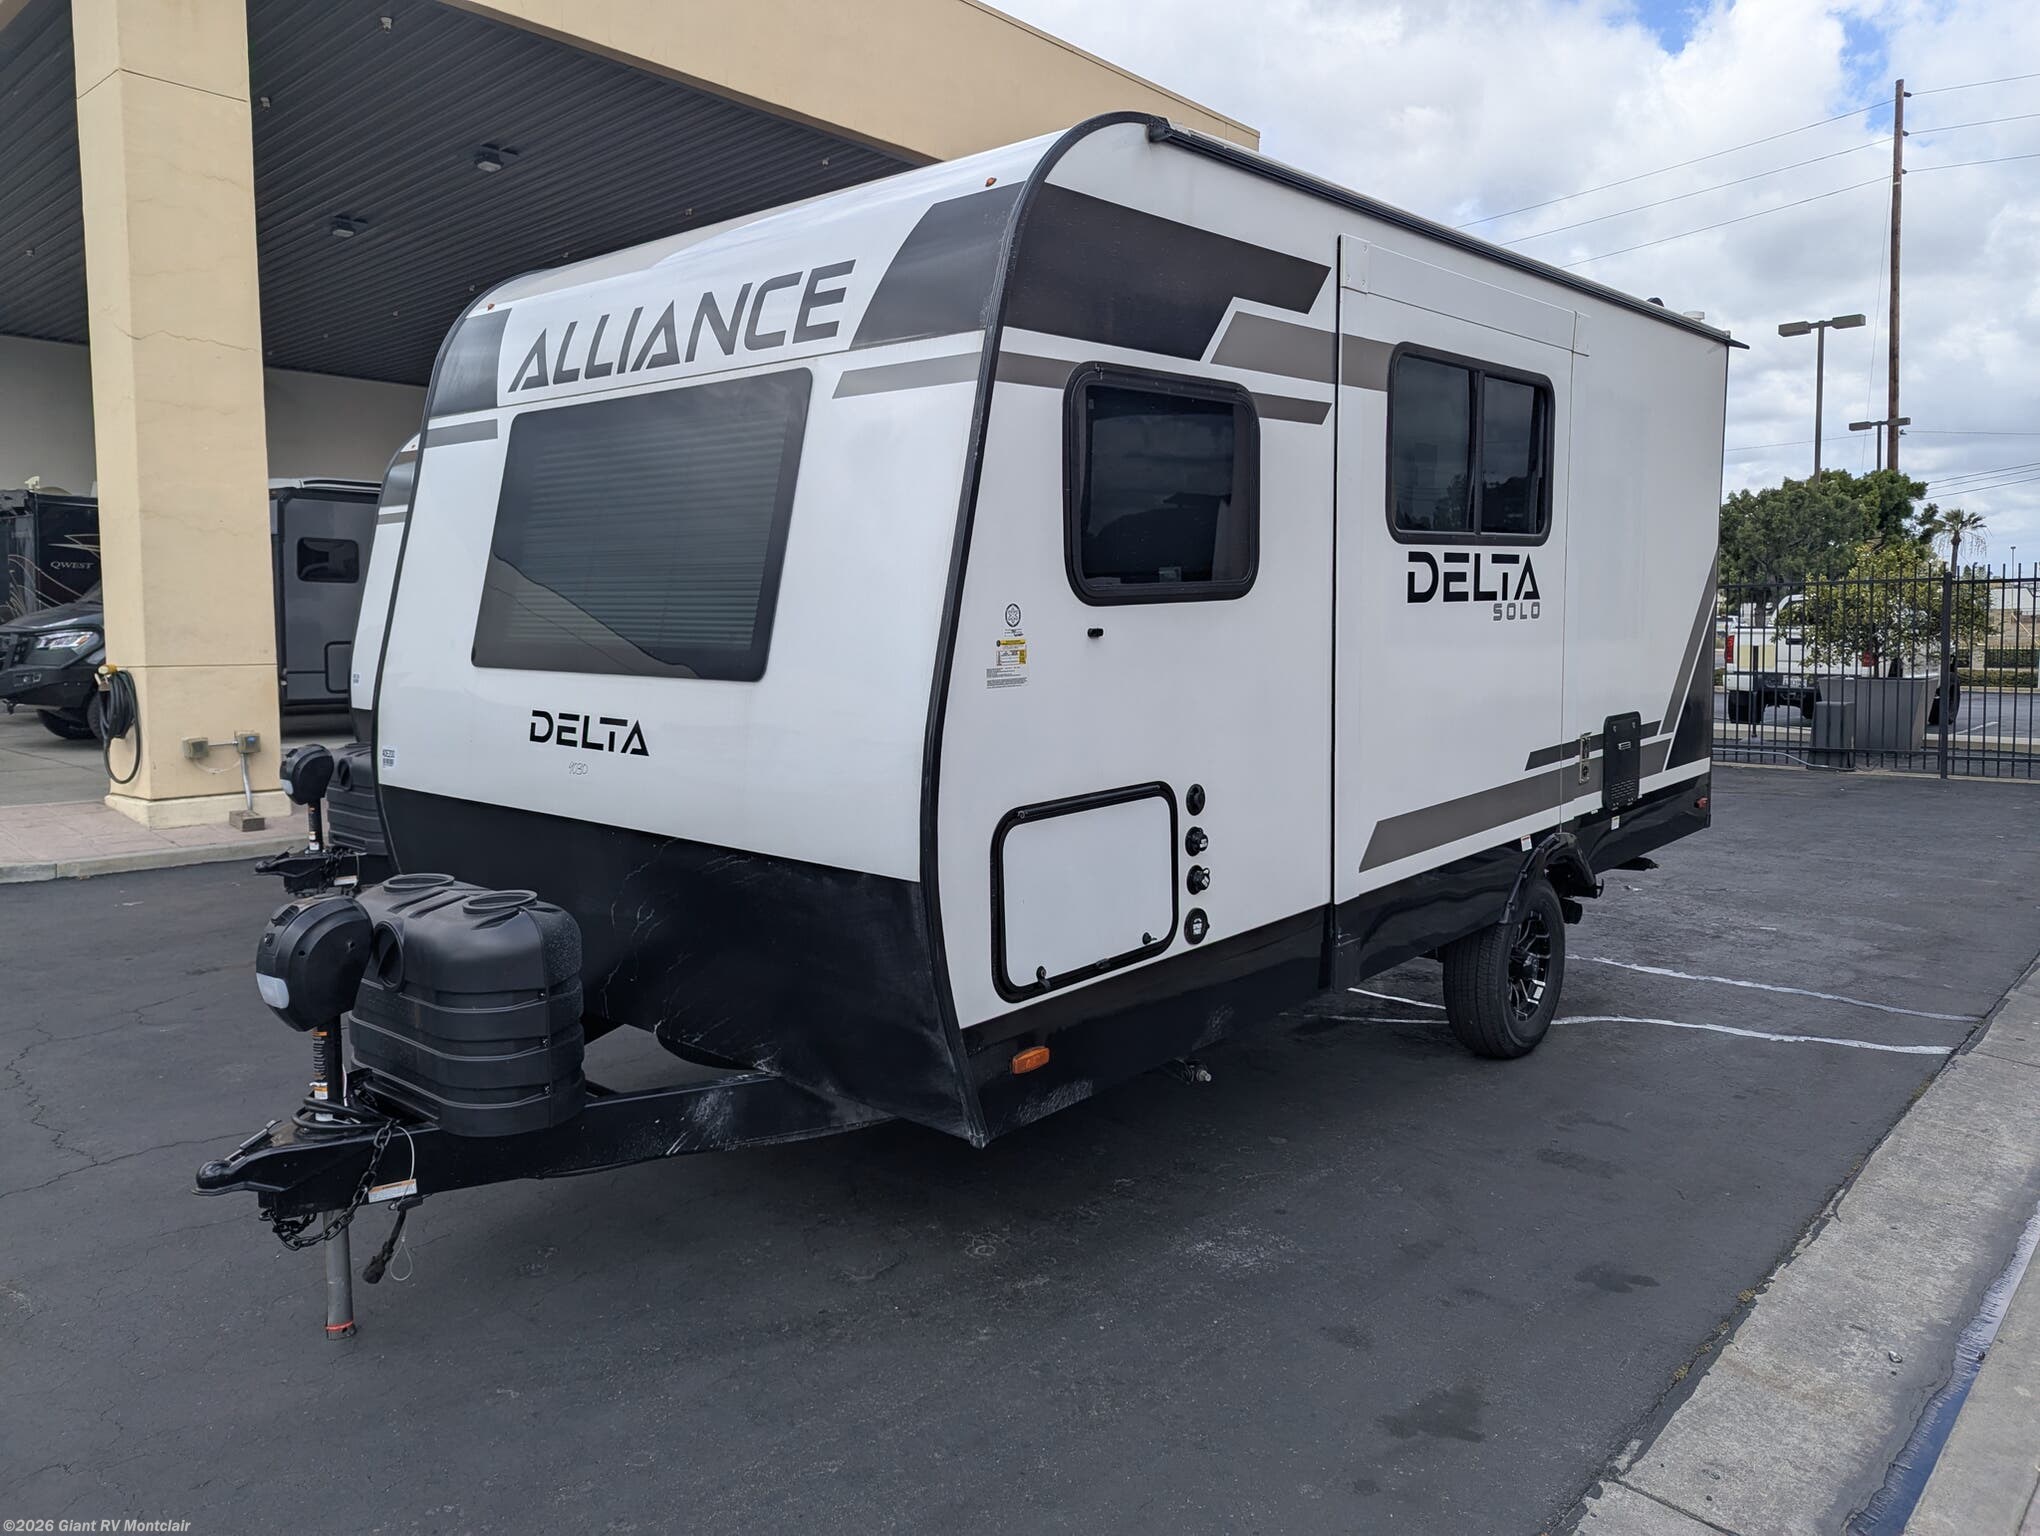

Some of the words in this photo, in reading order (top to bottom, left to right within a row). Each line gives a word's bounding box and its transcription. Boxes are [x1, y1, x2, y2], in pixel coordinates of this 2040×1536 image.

[507, 259, 857, 394] ALLIANCE
[50, 560, 96, 570] QWEST
[1407, 550, 1541, 604] DELTA
[1492, 601, 1541, 622] SOLO
[529, 709, 650, 757] DELTA
